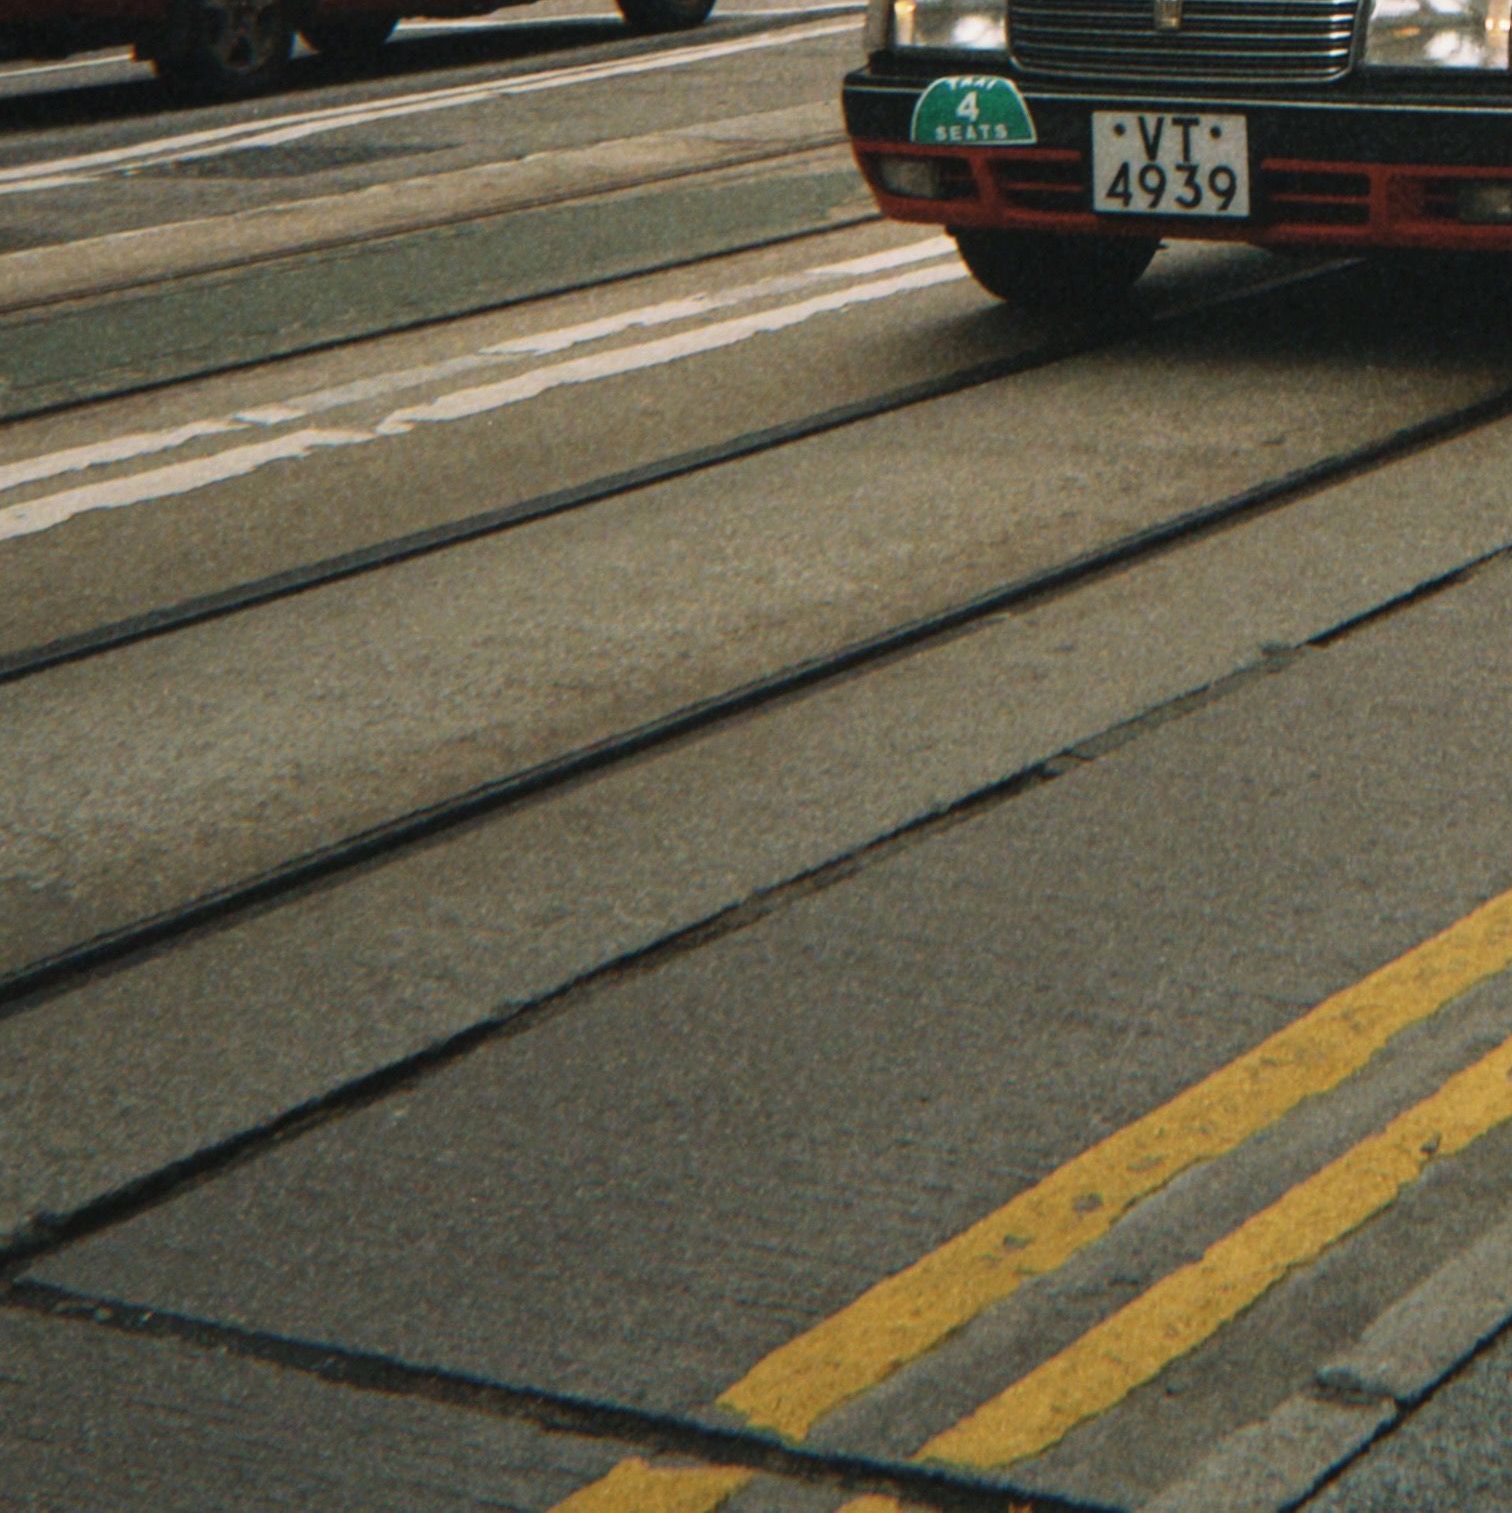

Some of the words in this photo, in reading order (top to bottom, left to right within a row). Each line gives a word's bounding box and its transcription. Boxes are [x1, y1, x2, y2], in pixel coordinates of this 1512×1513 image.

[956, 90, 980, 122] 4
[934, 123, 1008, 142] SEATS
[1138, 115, 1200, 162] VT
[1105, 161, 1238, 211] 4939
